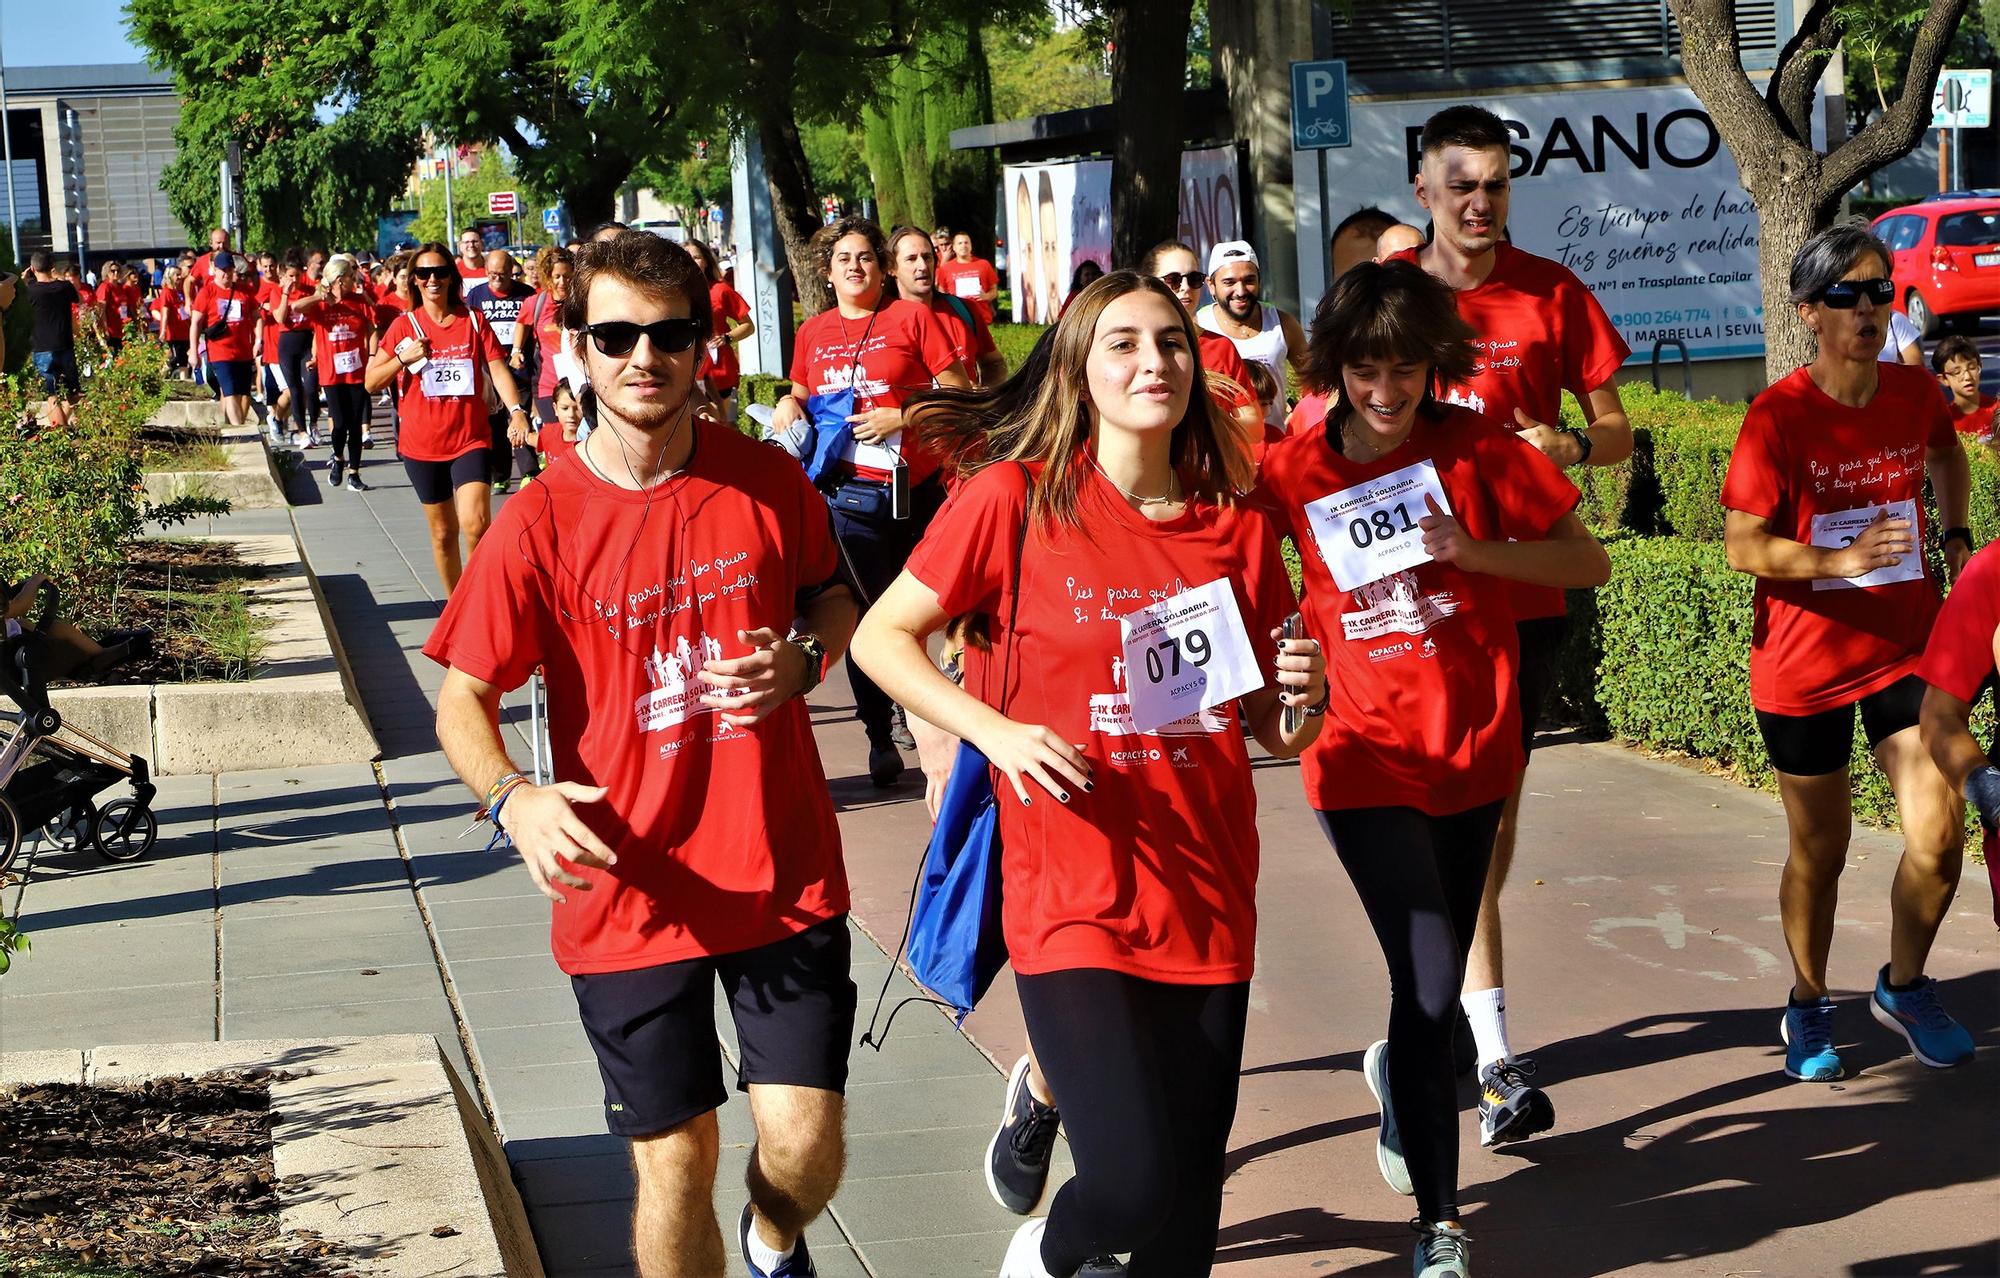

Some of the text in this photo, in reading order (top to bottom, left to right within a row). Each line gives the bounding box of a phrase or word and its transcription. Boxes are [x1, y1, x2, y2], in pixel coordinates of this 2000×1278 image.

[1306, 70, 1334, 108] P
[1406, 109, 1721, 184] SANO
[1558, 205, 1594, 238] Es
[1597, 203, 1674, 239] tiempo
[1682, 193, 1706, 220] de
[1606, 242, 1681, 270] sueños
[1622, 281, 1635, 289] en
[1639, 274, 1706, 289] Trasplante
[1709, 271, 1753, 285] Capilar
[481, 300, 523, 310] VA POR T
[1624, 309, 1711, 327] 900 264 774
[1635, 326, 1713, 343] MARBELLA
[435, 370, 461, 382] 236
[1810, 460, 1830, 478] Pies
[1839, 460, 1864, 478] para
[1867, 453, 1882, 471] qué
[1885, 445, 1898, 459] los
[1833, 478, 1857, 493] tengo
[1861, 471, 1883, 485] alas
[1330, 479, 1415, 513] IX CARRERA SOLIDARIA
[1348, 502, 1419, 549] 081
[1377, 544, 1404, 558] ACPACYS
[627, 584, 664, 613] para
[690, 559, 711, 578] los
[713, 551, 748, 579] quiero
[1066, 576, 1194, 607] Pies para qué lo
[1073, 606, 1128, 624] Si ten
[1163, 601, 1209, 622] SOLIDARIA
[1208, 605, 1221, 613] 2022
[1348, 602, 1432, 628] IX CARRERA SLIDARIA
[626, 612, 659, 630] tengo
[1378, 618, 1398, 628] ANDA
[1145, 629, 1212, 684] 079
[1368, 643, 1404, 658] ACPACYS
[1170, 680, 1198, 697] ACPACYS
[640, 705, 652, 716] IX
[652, 691, 690, 711] CARRERA
[1098, 704, 1107, 715] IX
[1111, 749, 1148, 760] ACPACYS
